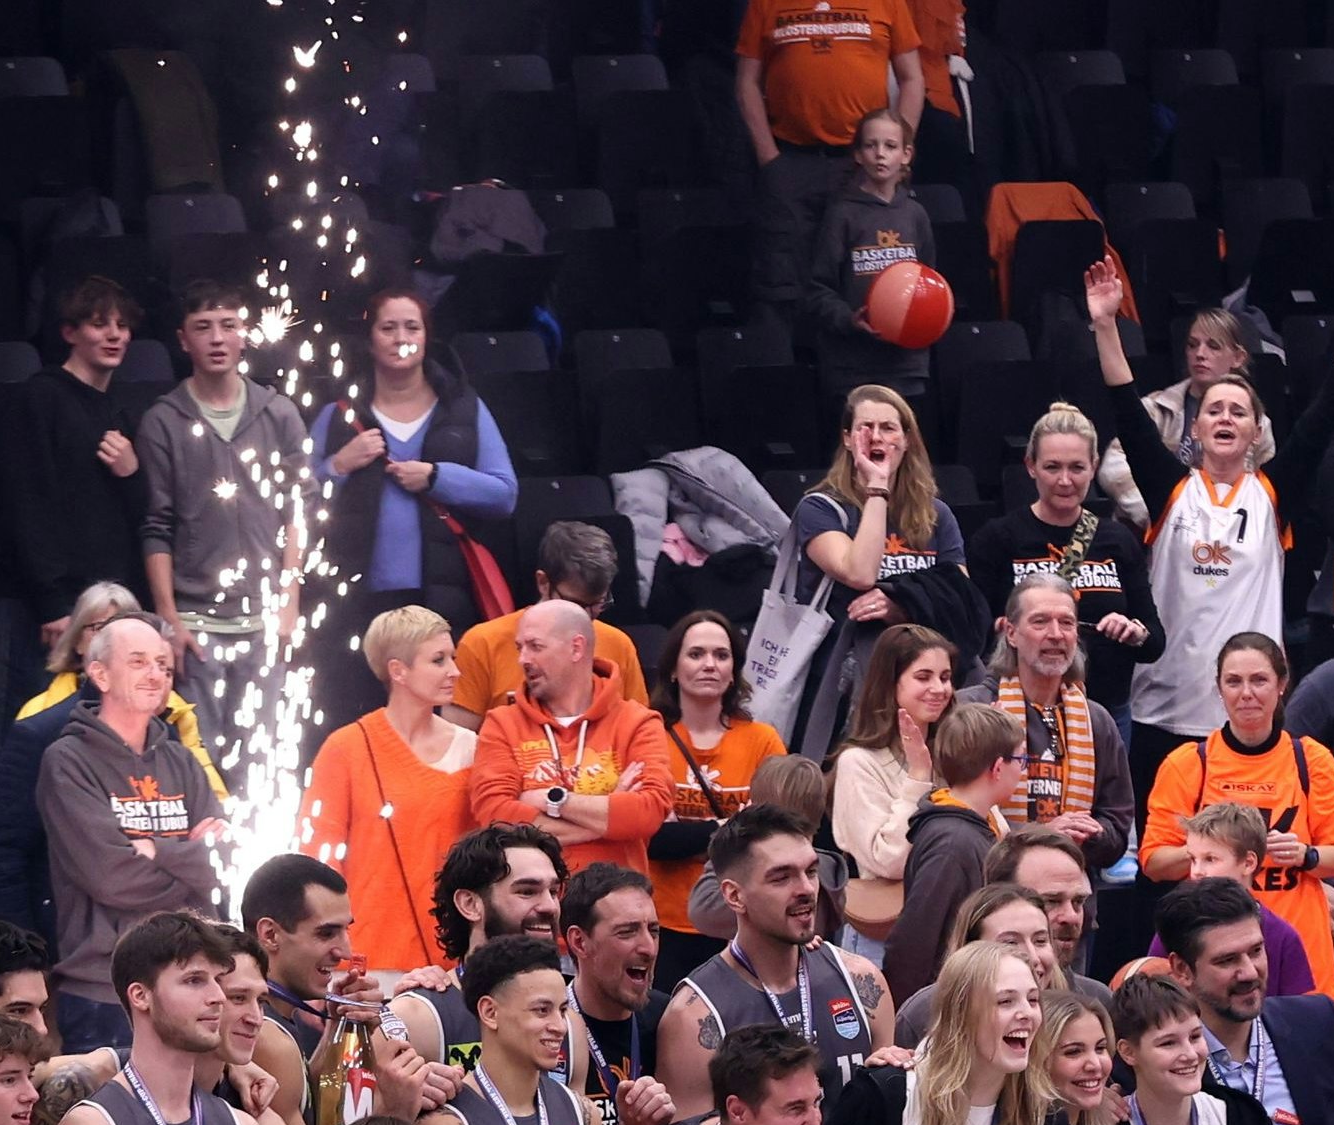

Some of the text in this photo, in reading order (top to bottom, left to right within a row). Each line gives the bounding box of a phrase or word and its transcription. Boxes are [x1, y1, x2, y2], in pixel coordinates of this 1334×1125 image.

[1192, 540, 1232, 566] bk
[1013, 561, 1119, 576] BASKBALL
[1193, 565, 1229, 577] dukes
